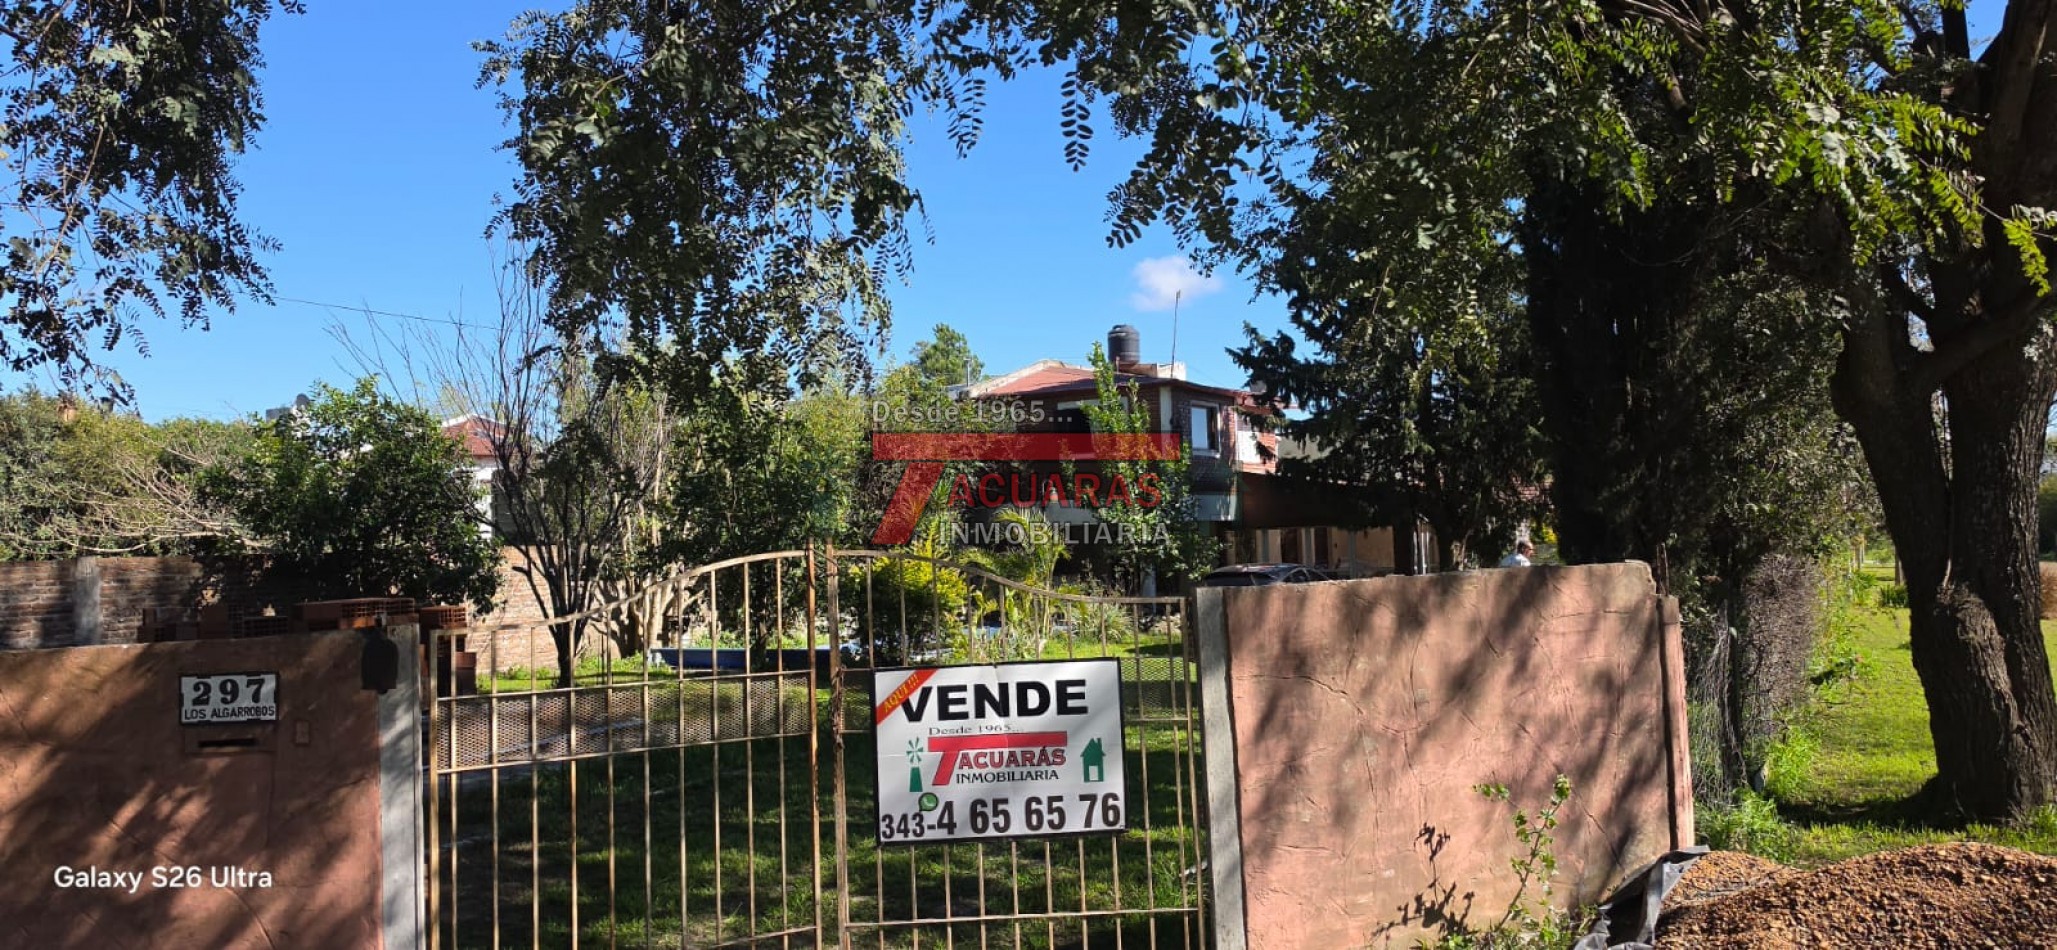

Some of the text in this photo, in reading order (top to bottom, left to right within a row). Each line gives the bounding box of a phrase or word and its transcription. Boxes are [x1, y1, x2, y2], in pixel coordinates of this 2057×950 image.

[192, 678, 266, 706] 297
[901, 679, 1089, 723] VENDE
[184, 706, 275, 720] LOS ALGARROBOS
[929, 726, 972, 736] Desde
[956, 769, 1059, 784] INMOBILIARIA
[970, 797, 1012, 835] 65
[1024, 794, 1066, 832] 65
[1078, 792, 1121, 829] 76
